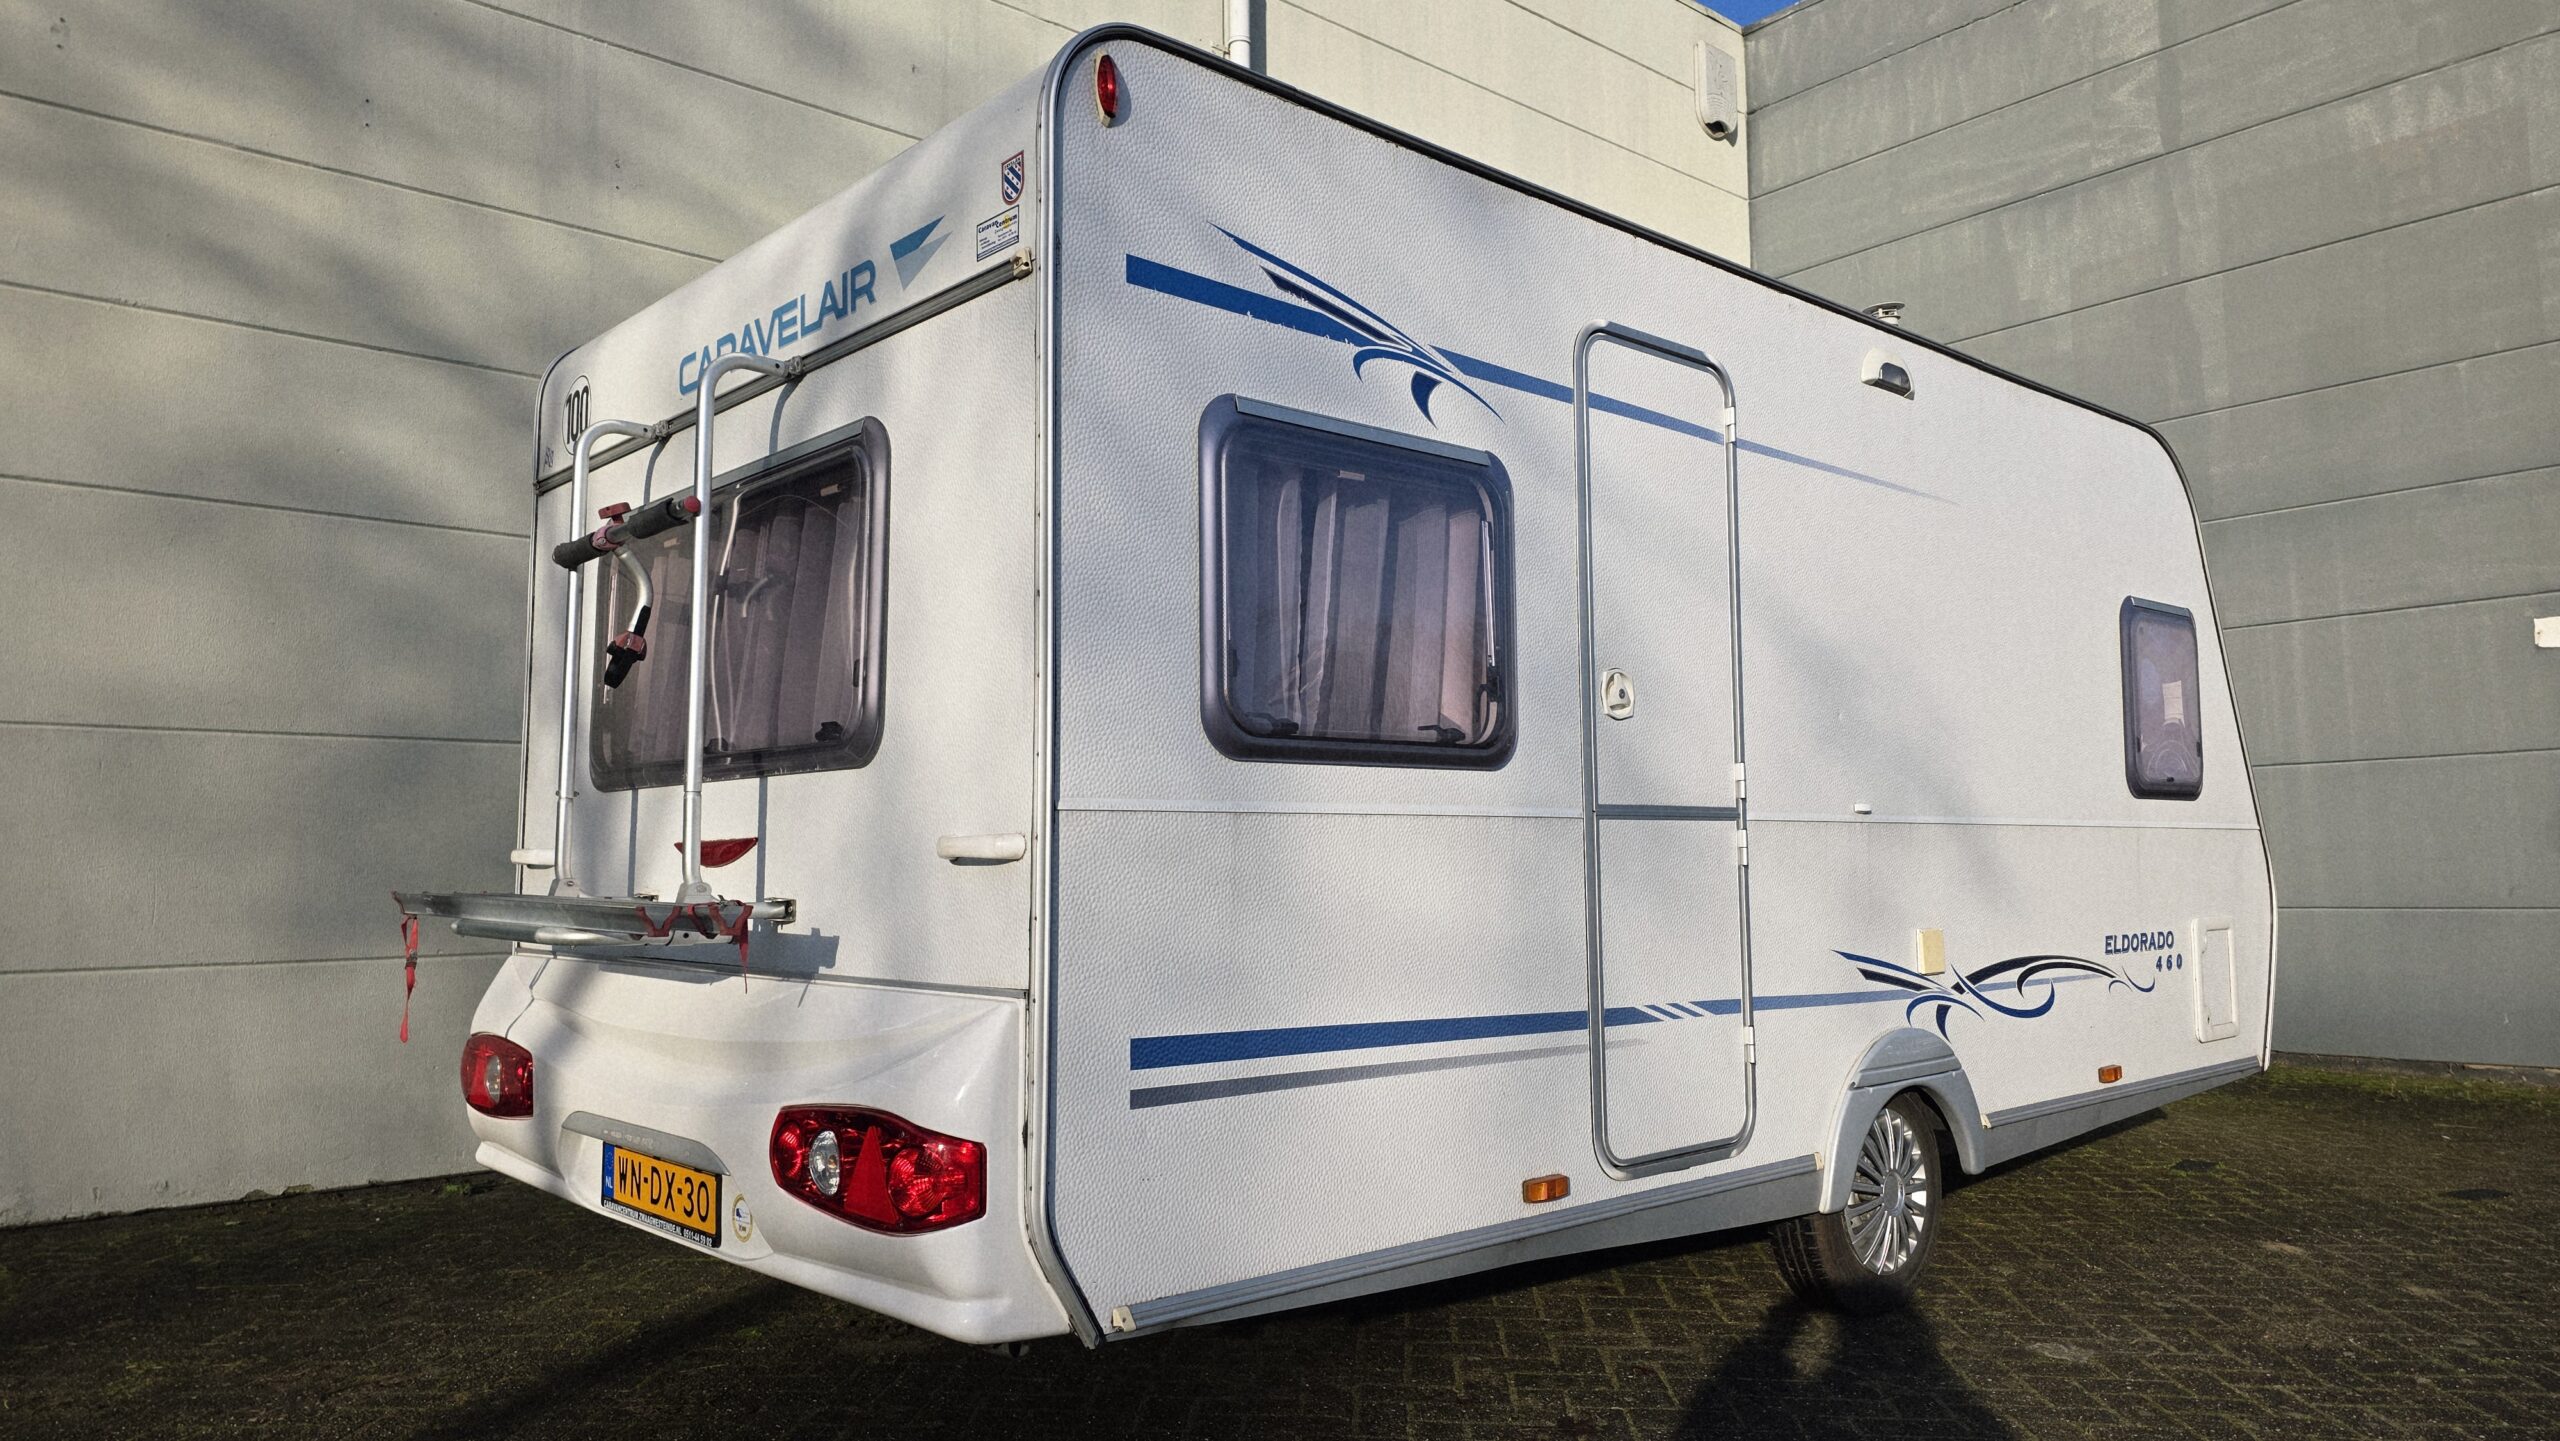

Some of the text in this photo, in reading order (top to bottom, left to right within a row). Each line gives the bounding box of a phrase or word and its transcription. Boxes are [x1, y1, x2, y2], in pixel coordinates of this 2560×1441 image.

[565, 385, 590, 445] 100
[2104, 930, 2175, 955] ELDORADO
[605, 1175, 613, 1190] NL
[618, 1155, 710, 1222] WN-DX-30
